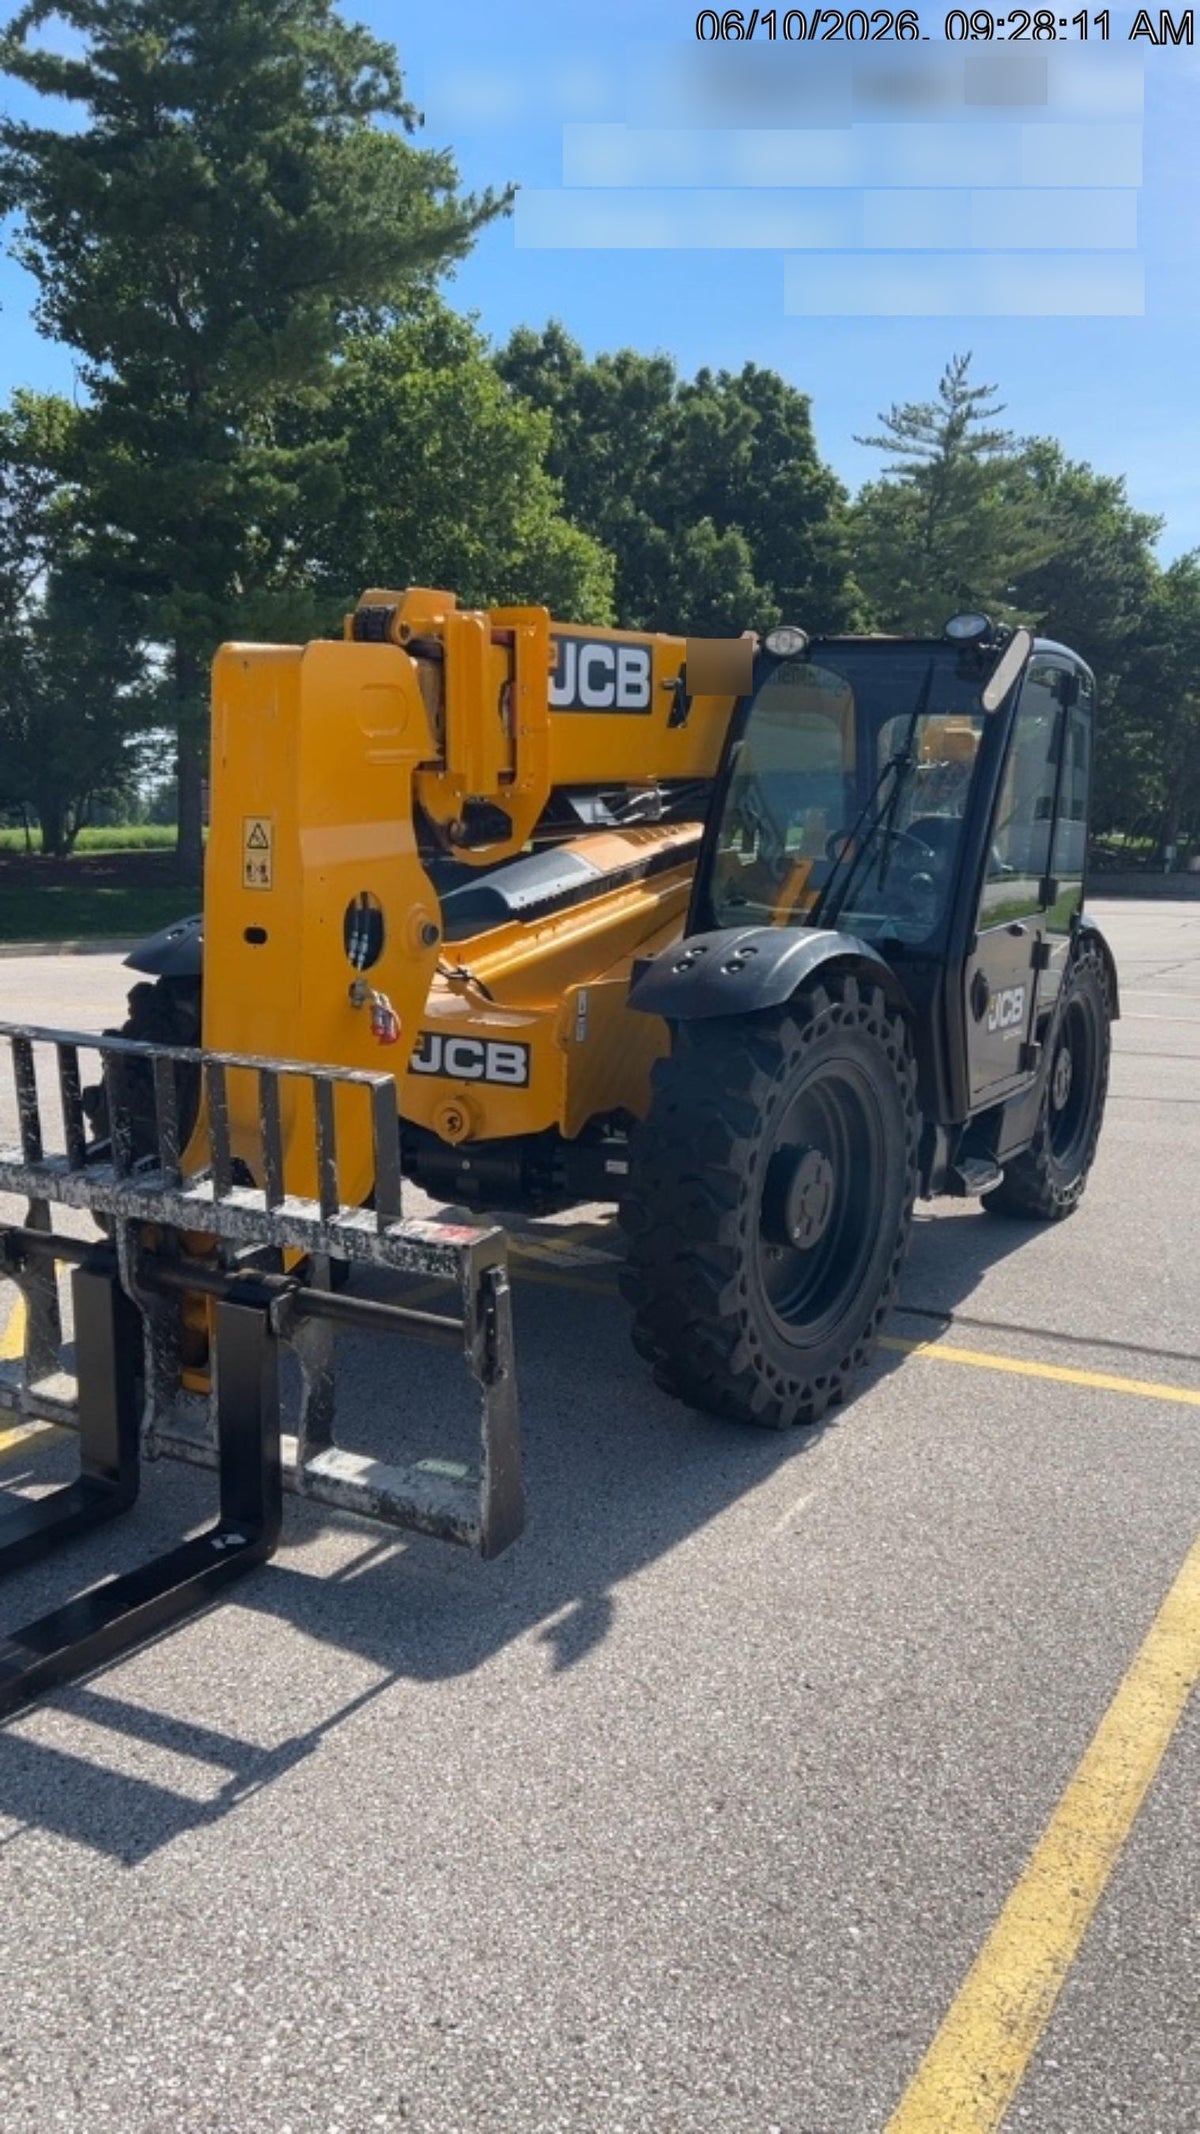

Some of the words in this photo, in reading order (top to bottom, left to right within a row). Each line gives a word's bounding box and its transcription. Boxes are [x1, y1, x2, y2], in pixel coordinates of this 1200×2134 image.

[548, 641, 651, 708] JCB
[988, 986, 1024, 1031] JCB
[411, 1035, 528, 1083] JCB
